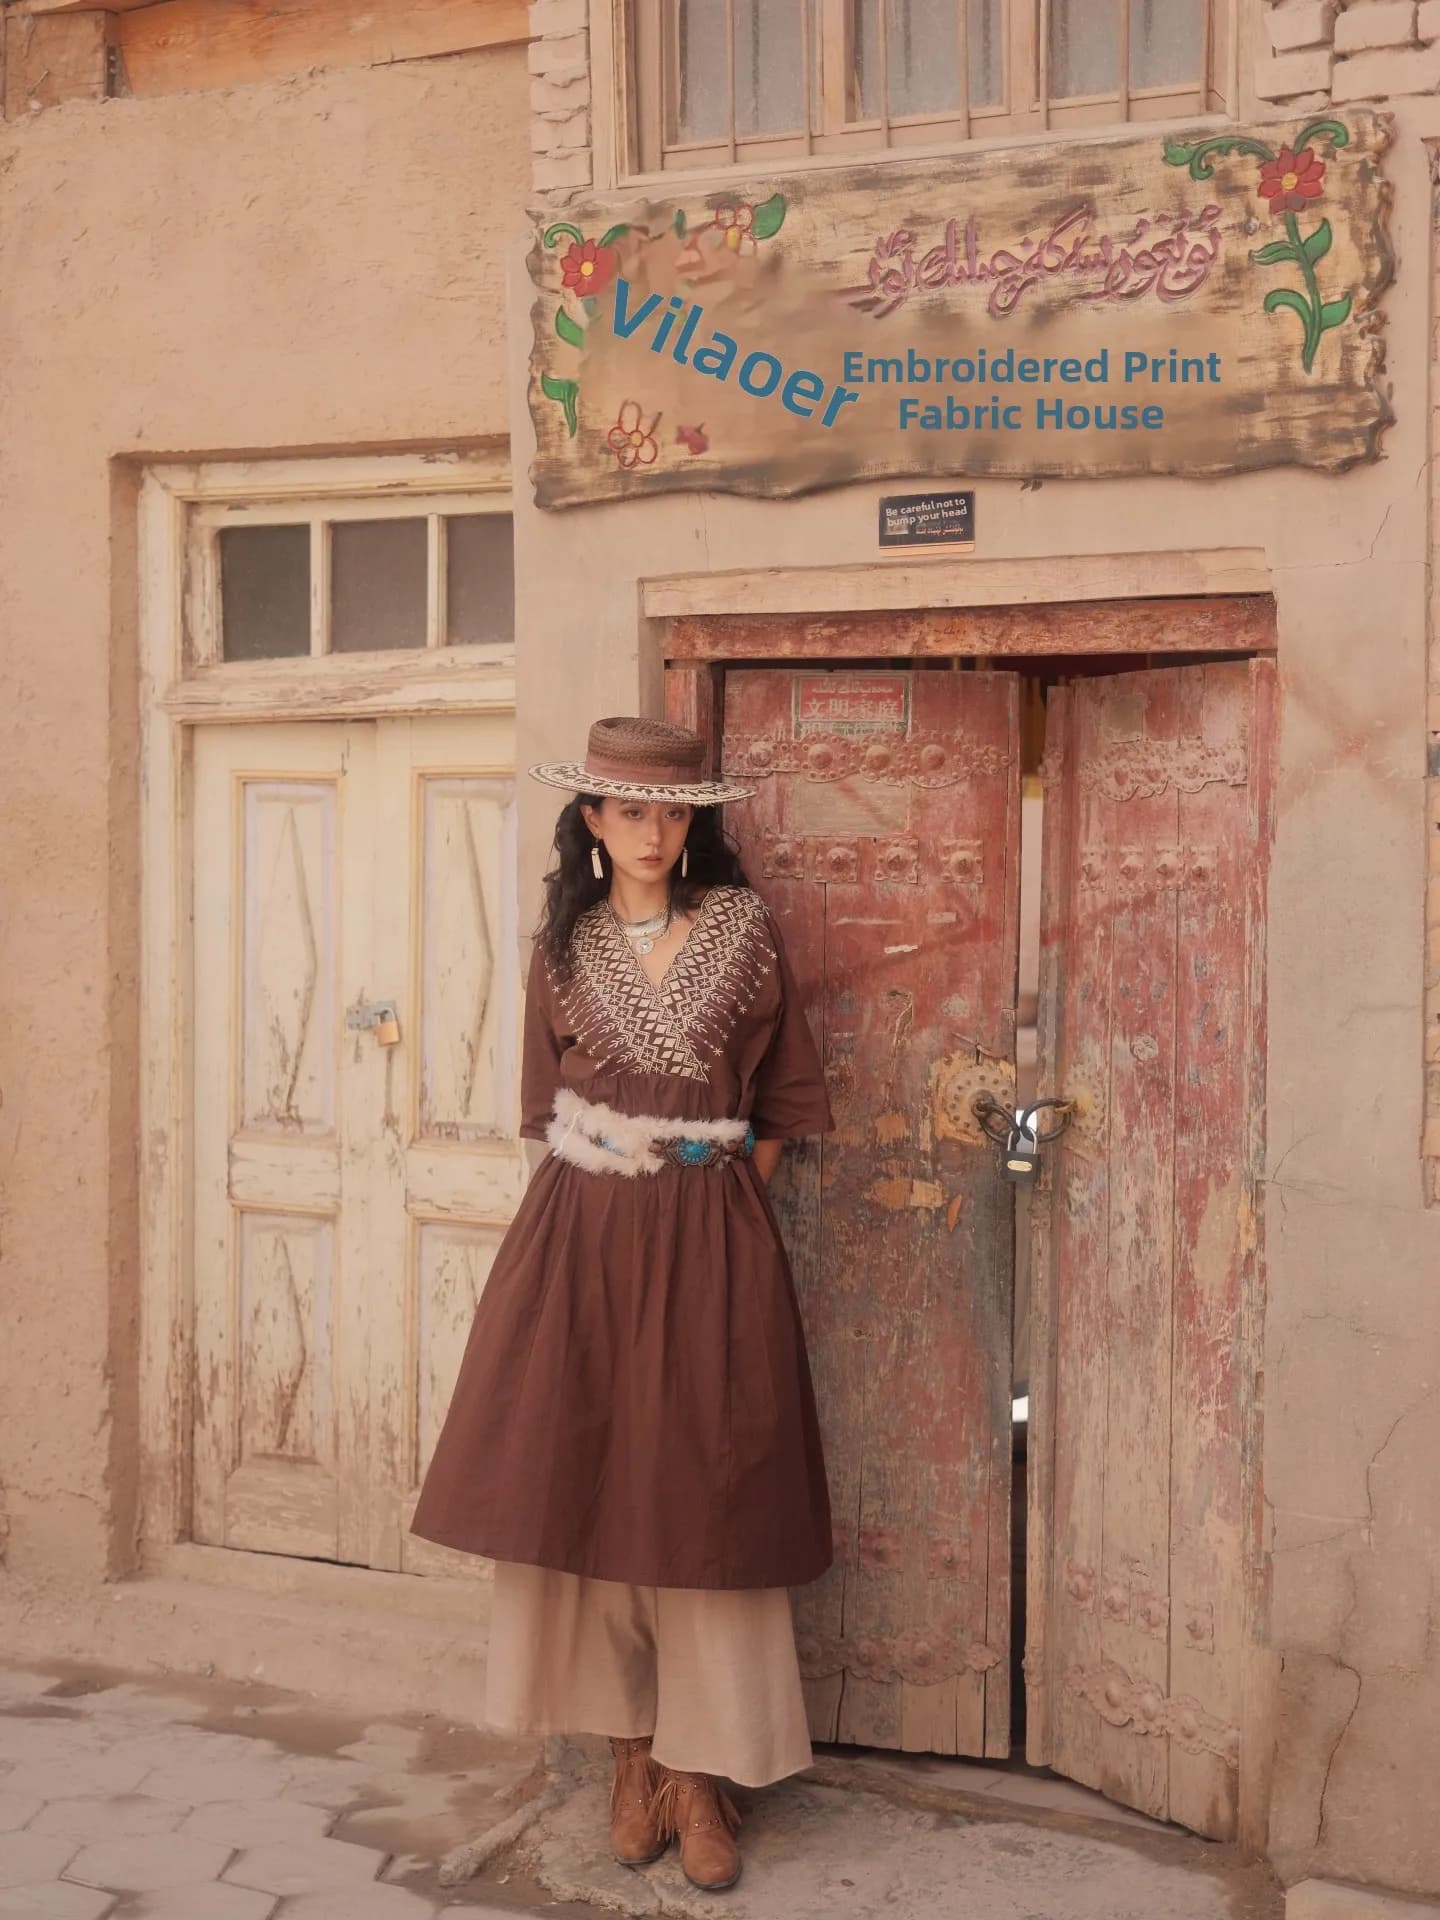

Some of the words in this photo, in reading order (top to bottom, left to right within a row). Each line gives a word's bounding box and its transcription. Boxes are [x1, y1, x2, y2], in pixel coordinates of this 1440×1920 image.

[612, 278, 859, 428] Vilaoer
[843, 348, 1108, 383] Embroidered
[1125, 348, 1221, 383] Print
[900, 395, 1021, 429] Fabric
[1036, 398, 1164, 429] House
[886, 508, 898, 516] Be
[900, 500, 935, 514] careful
[936, 499, 954, 508] not
[955, 498, 966, 506] to
[887, 515, 916, 526] bump
[917, 512, 940, 523] your
[941, 506, 967, 518] head
